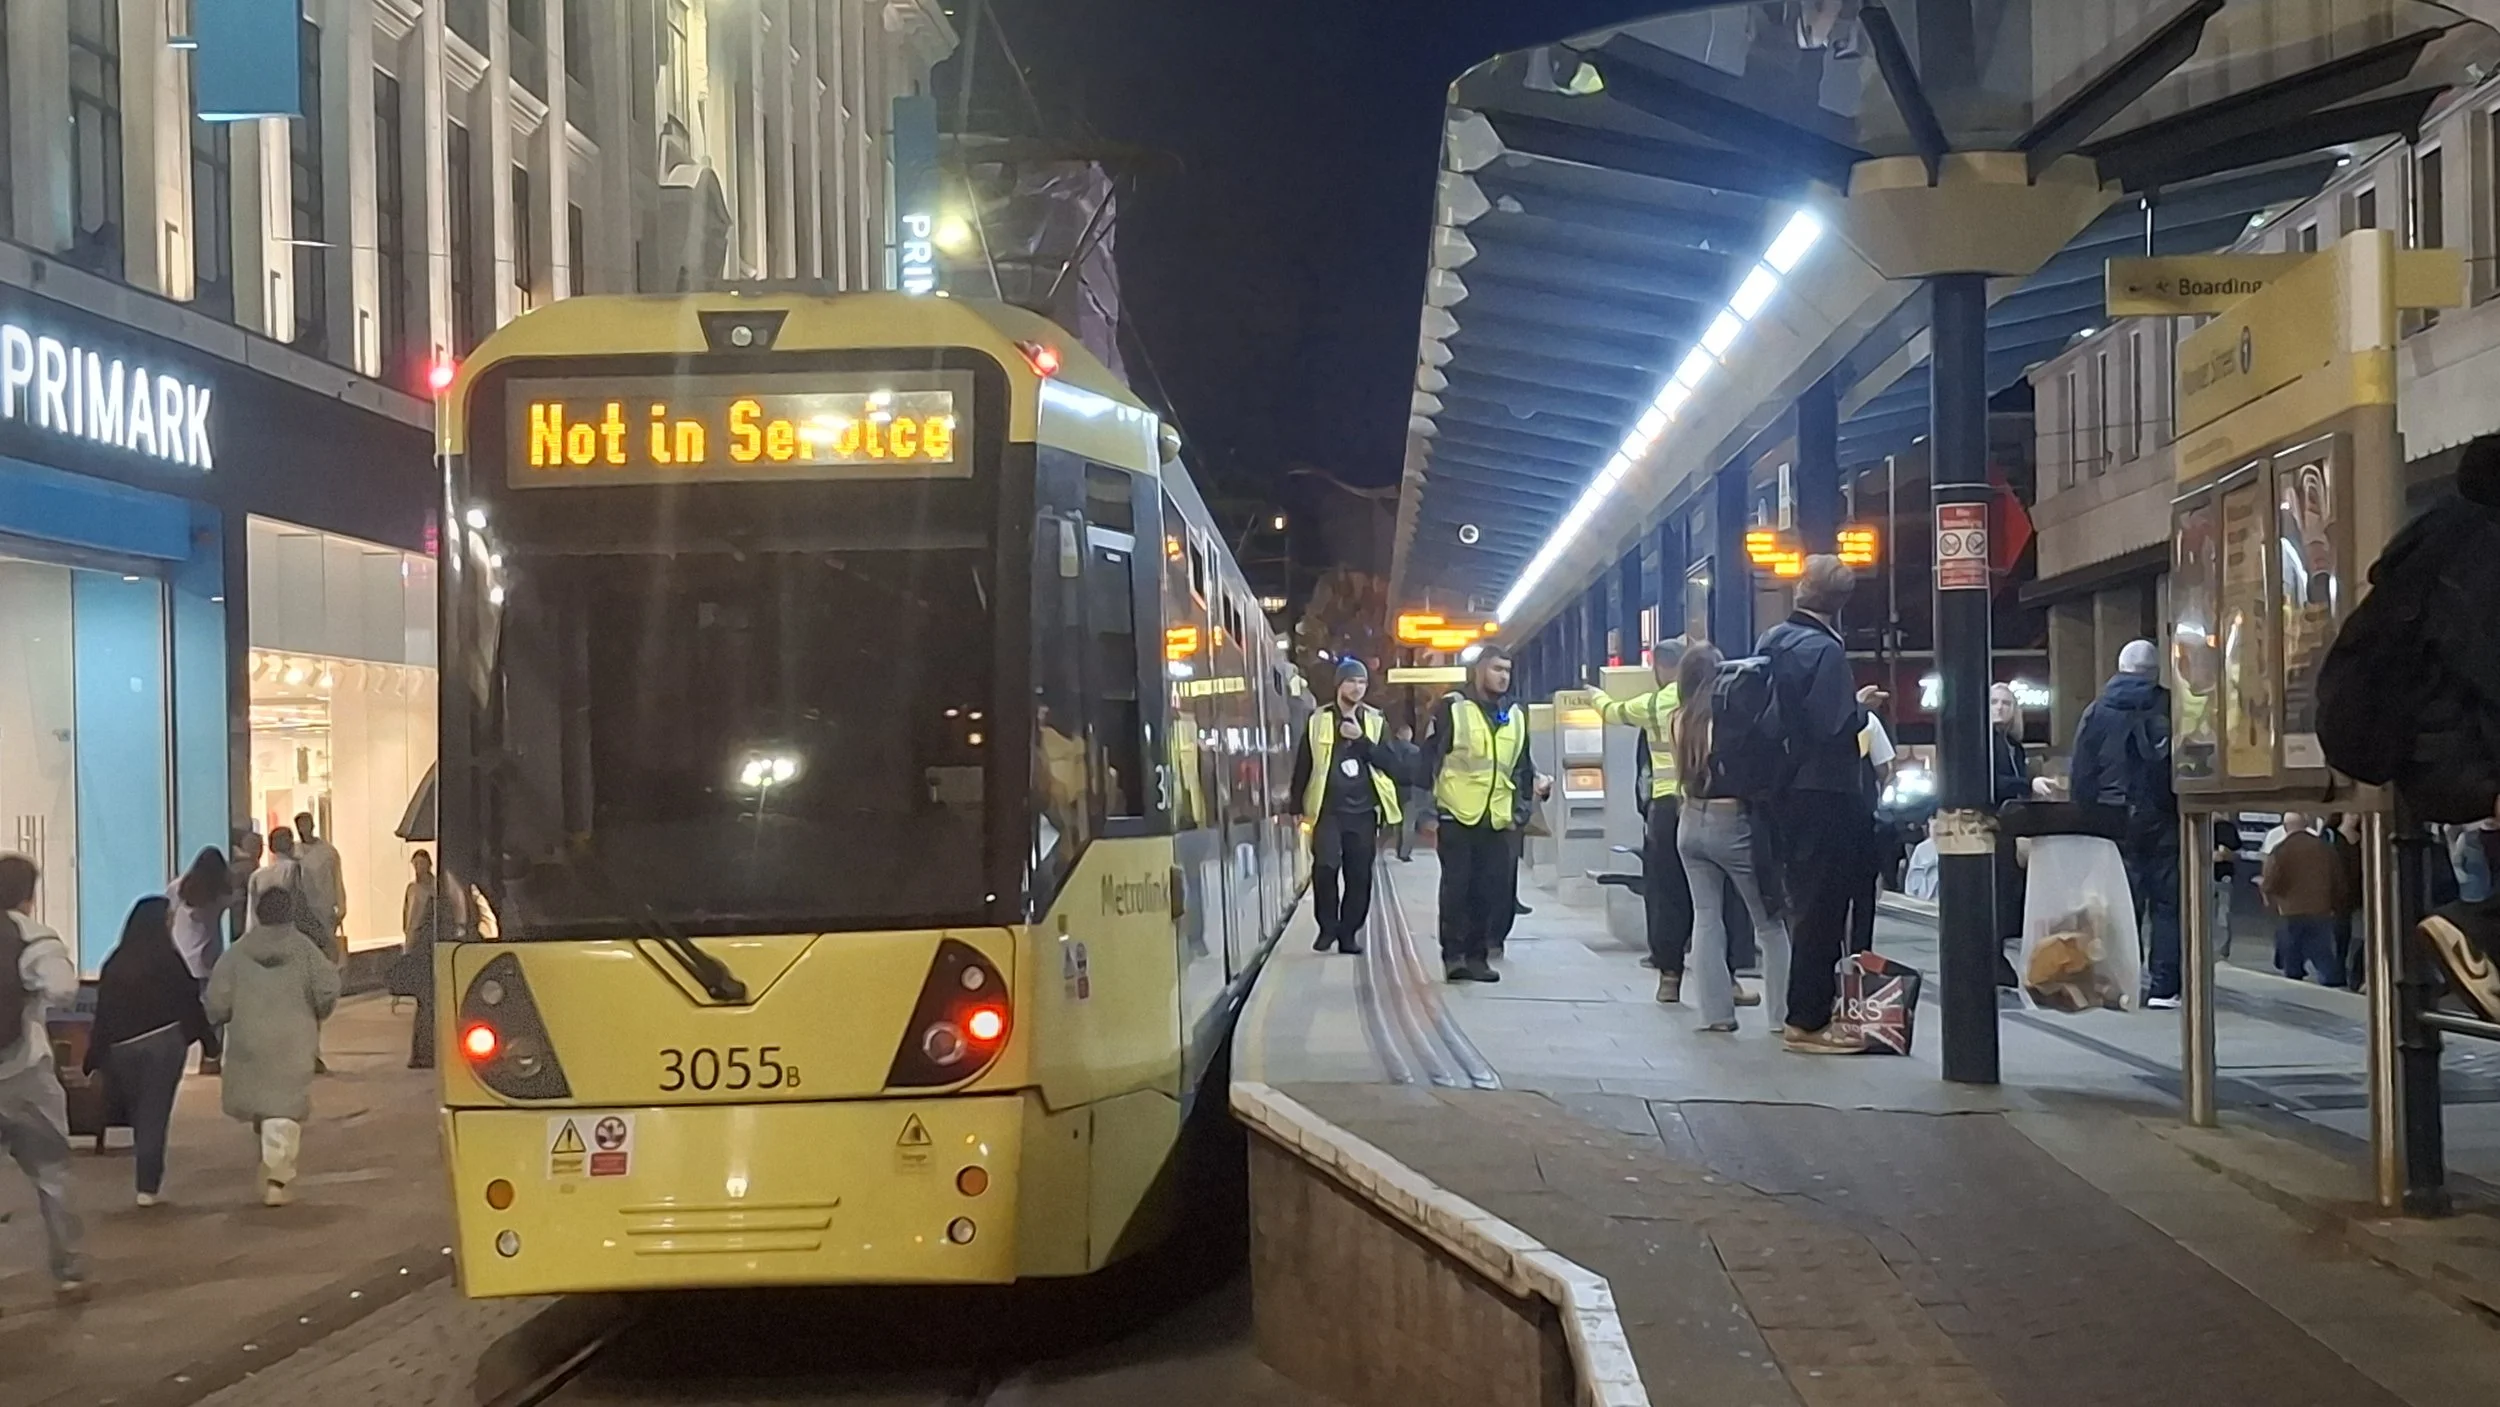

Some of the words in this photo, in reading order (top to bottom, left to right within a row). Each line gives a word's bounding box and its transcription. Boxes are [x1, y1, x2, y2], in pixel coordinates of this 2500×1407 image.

[1, 323, 213, 470] PRIMARK
[531, 402, 626, 466] Not
[651, 404, 705, 464] in
[729, 399, 952, 461] Service
[1101, 871, 1170, 917] Metrolink
